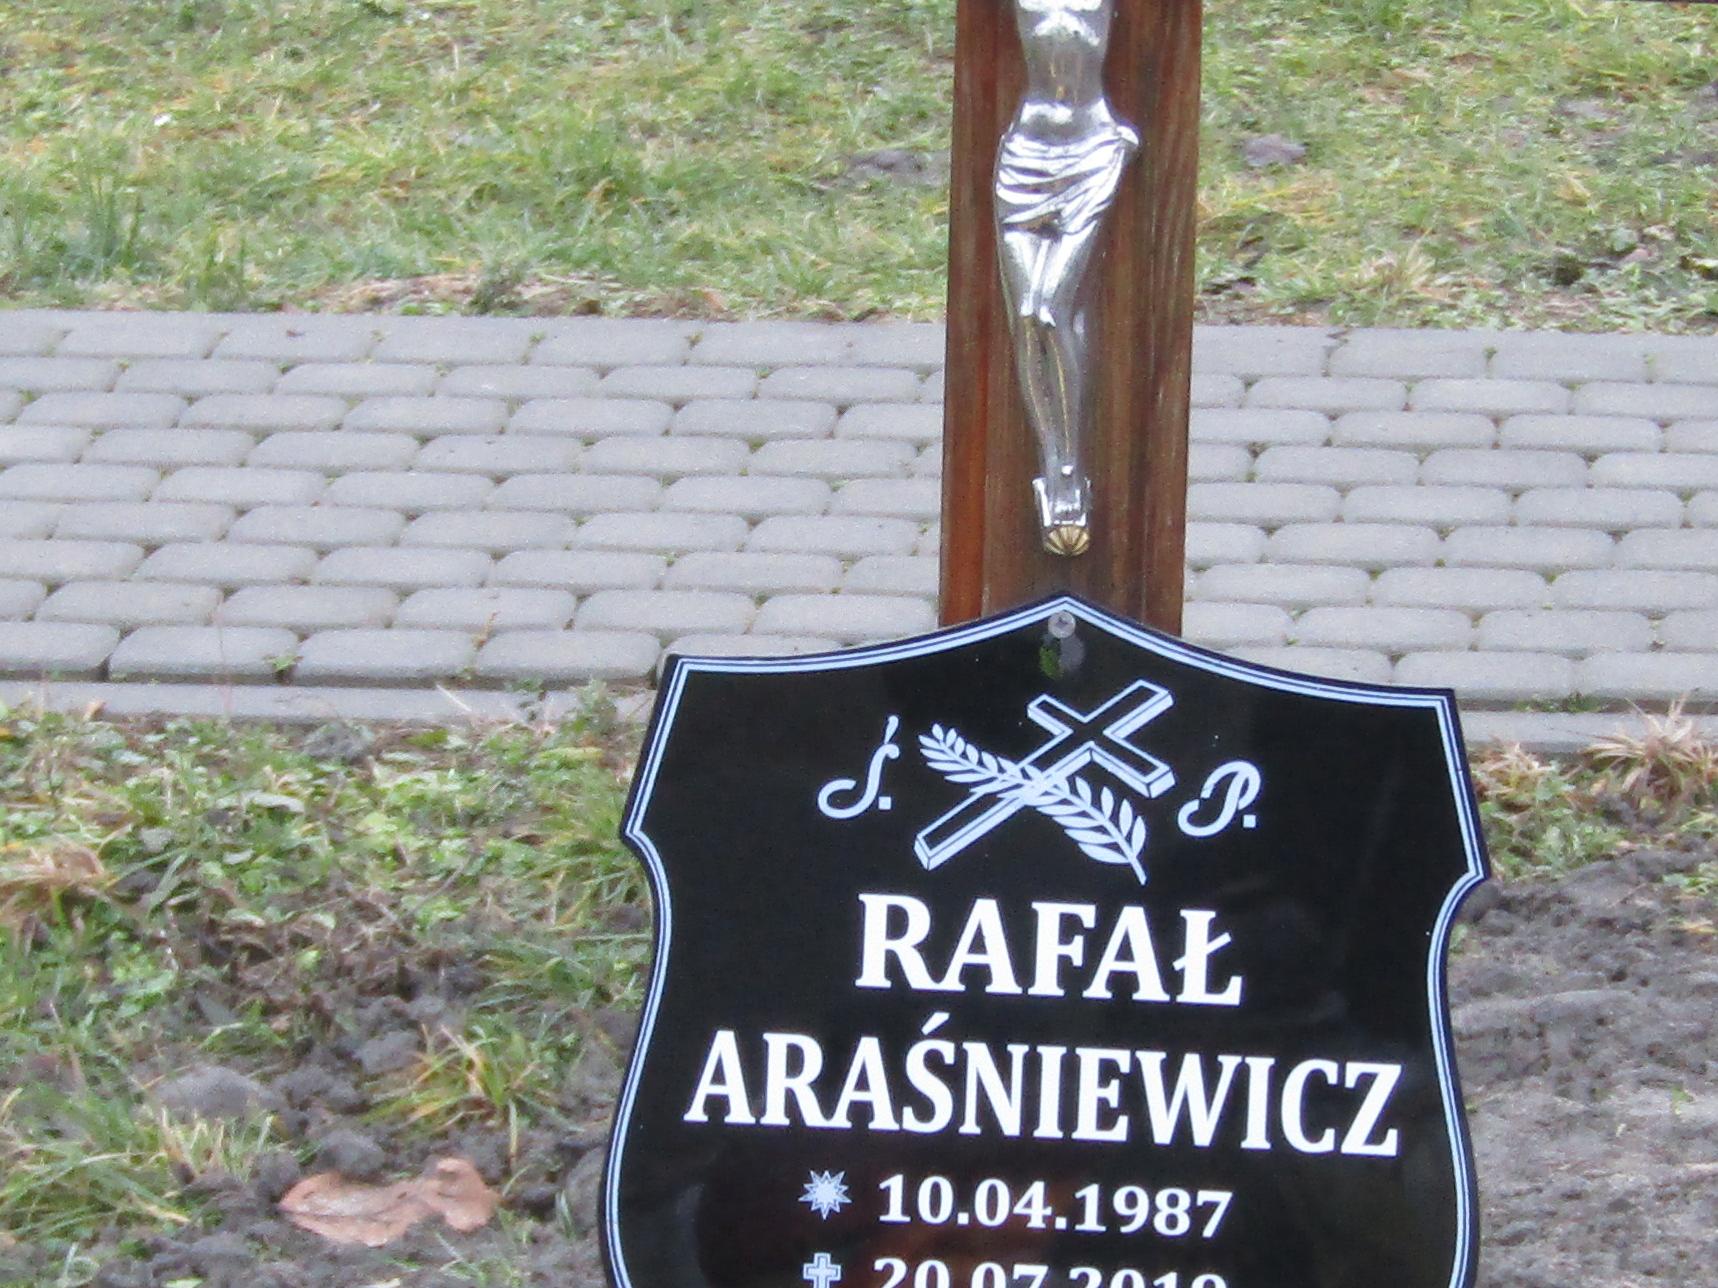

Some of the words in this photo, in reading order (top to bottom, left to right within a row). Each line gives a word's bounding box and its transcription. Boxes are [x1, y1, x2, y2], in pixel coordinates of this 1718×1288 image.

[855, 892, 1243, 1006] RAFAŁ
[684, 1012, 1401, 1157] ARAŚNIEWICZ
[878, 1174, 1233, 1238] 10.04.1987
